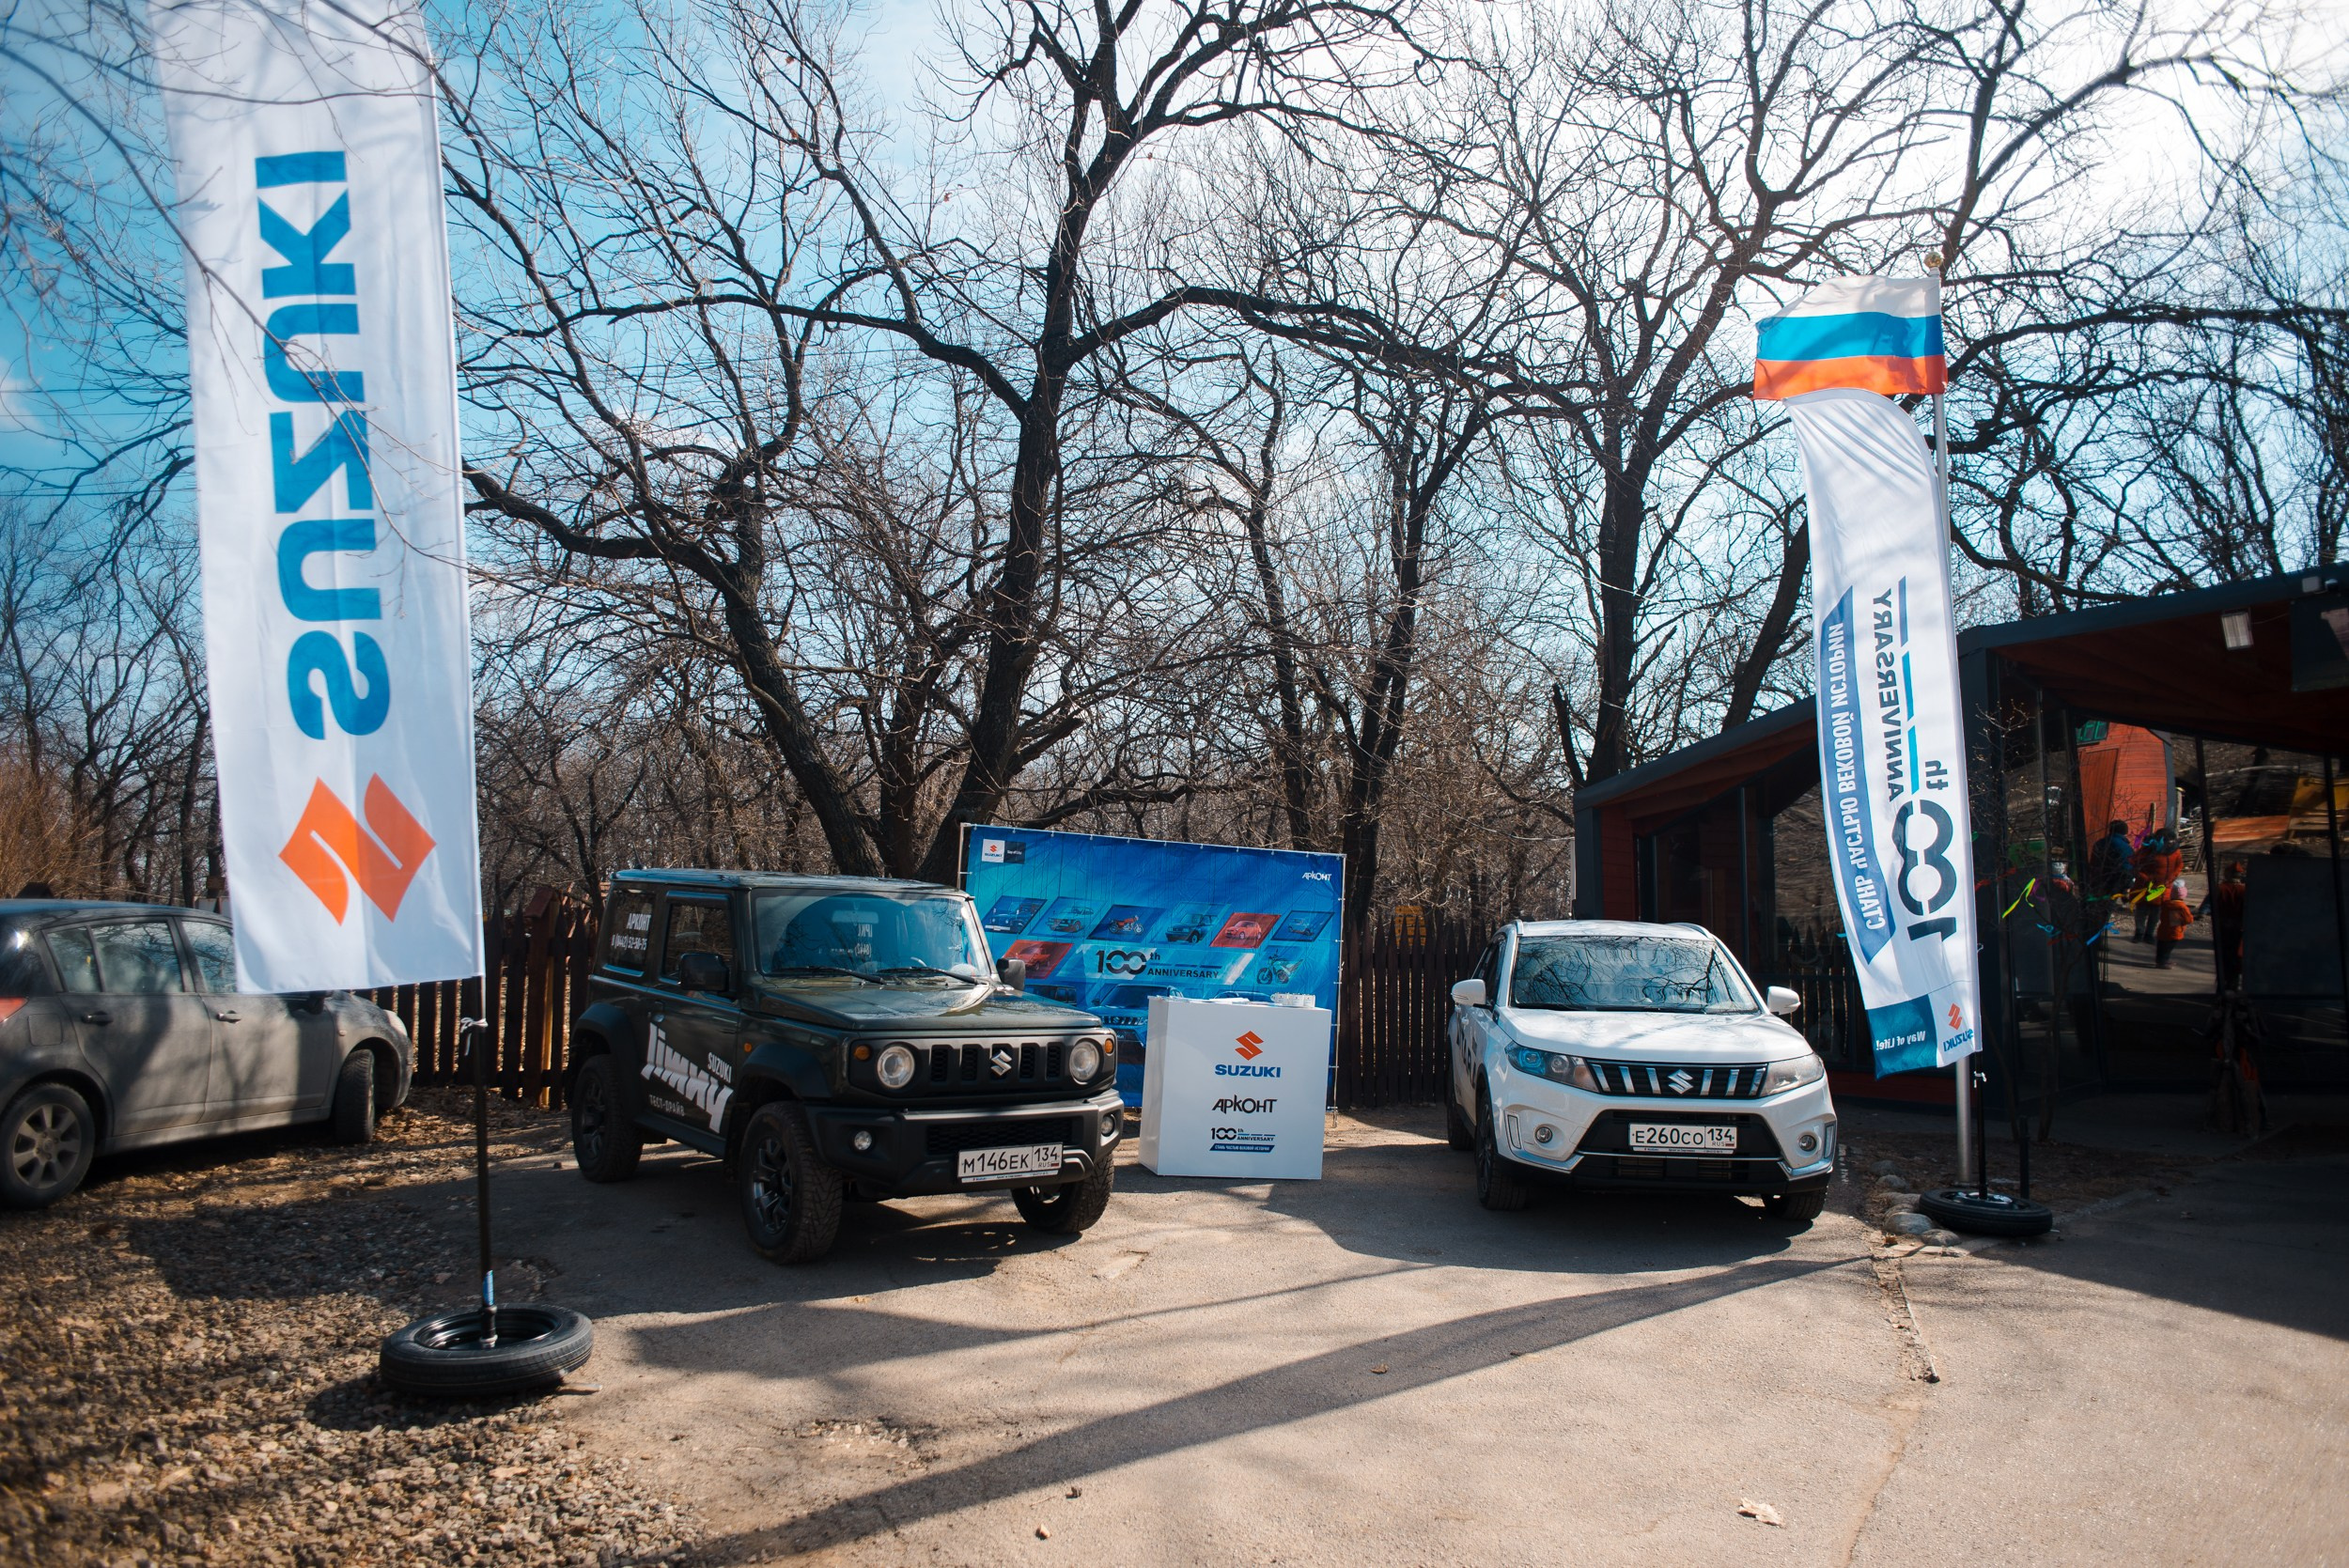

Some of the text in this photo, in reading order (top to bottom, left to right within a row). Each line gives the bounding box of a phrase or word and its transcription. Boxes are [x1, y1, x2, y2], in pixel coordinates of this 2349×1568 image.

[1147, 968, 1220, 979] ANNIVERSARY
[708, 1051, 732, 1083] SUZUKI
[1215, 1063, 1282, 1078] SUZUKI
[1707, 1128, 1733, 1141] 134
[1034, 1146, 1058, 1161] 134
